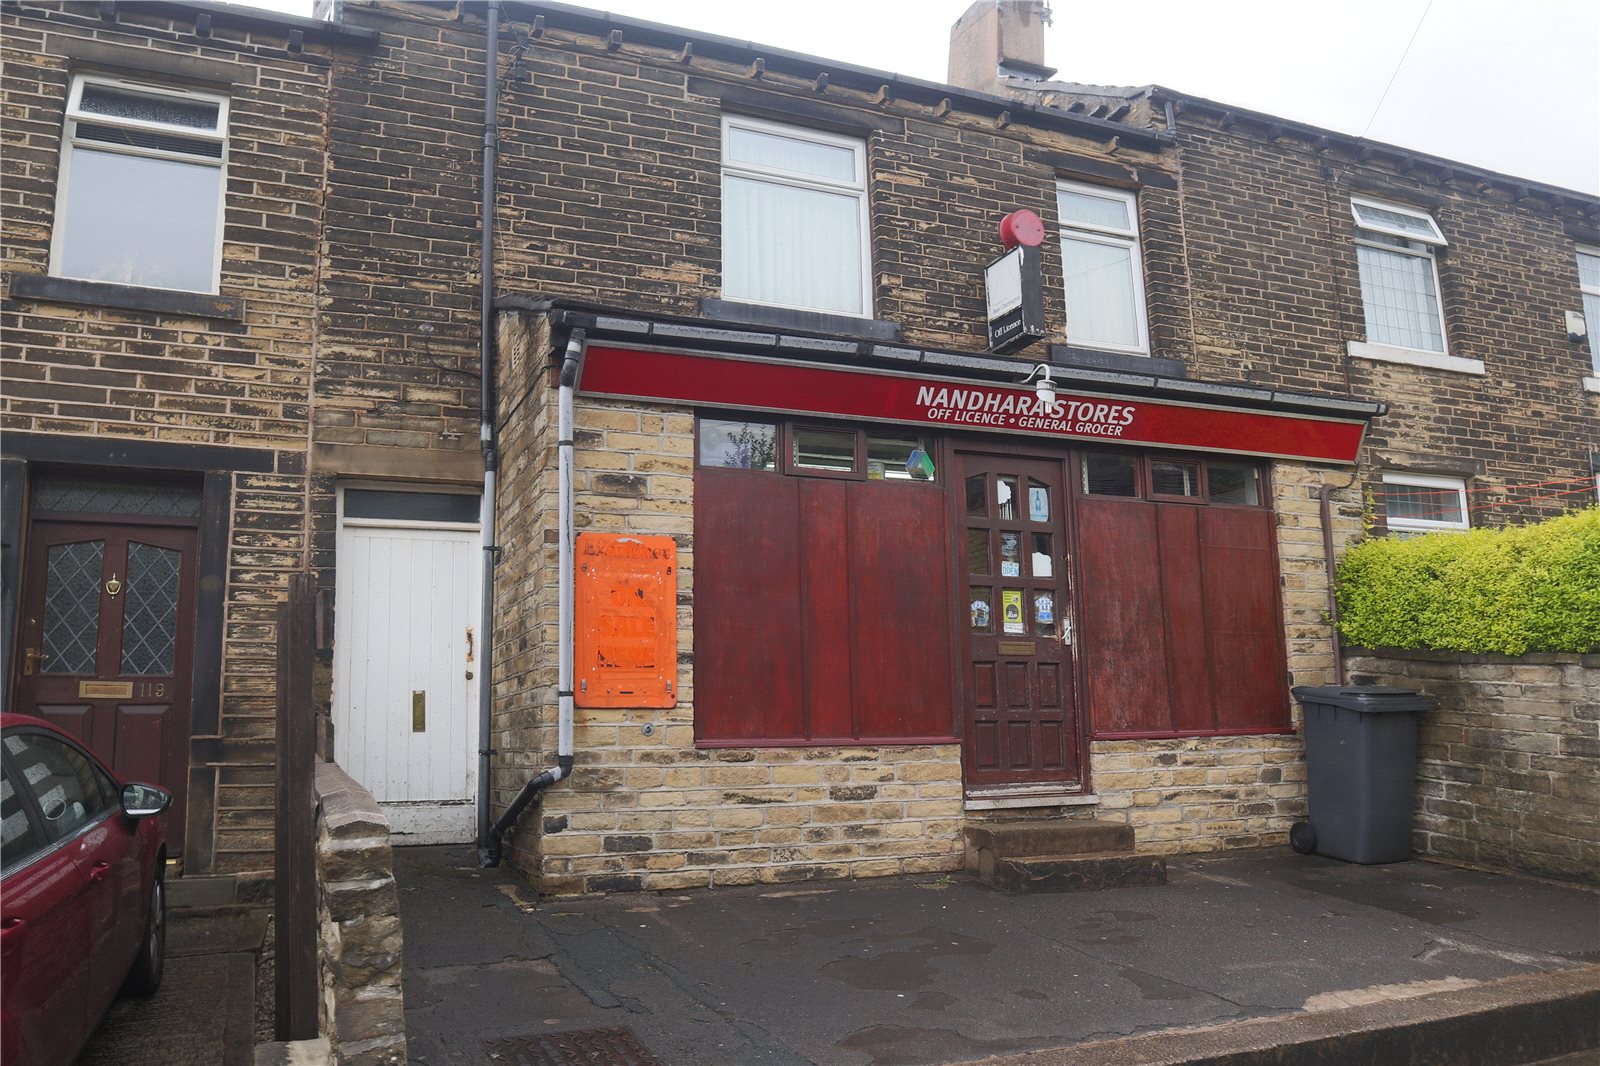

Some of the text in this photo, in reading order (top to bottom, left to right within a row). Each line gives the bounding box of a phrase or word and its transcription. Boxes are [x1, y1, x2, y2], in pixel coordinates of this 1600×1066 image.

[916, 386, 1136, 426] NANDHARA STORES
[927, 407, 1123, 437] OFF LICENCE GENERAL GROCER
[140, 683, 165, 697] 119
